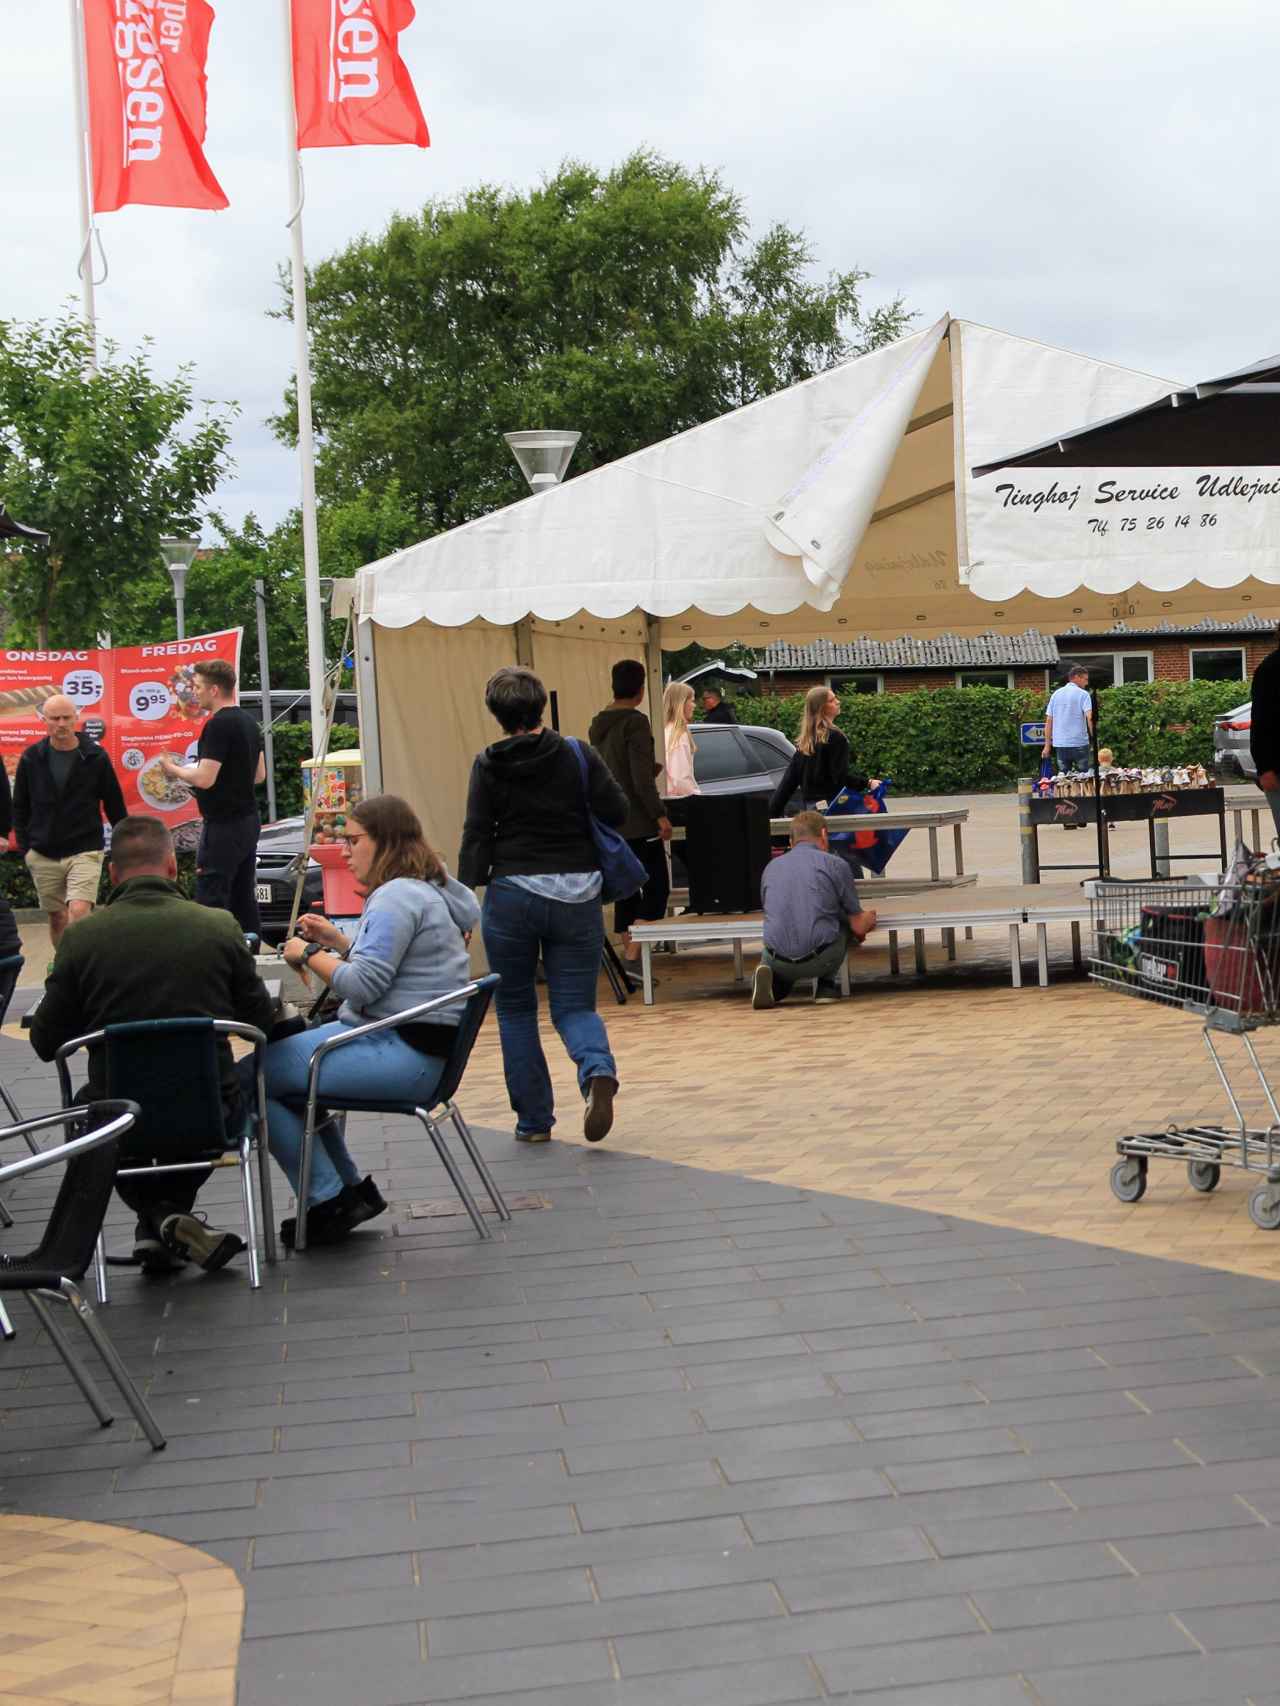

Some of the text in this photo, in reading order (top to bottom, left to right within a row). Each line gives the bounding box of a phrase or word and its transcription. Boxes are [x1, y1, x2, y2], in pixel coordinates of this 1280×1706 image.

[1095, 480, 1180, 504] Service
[1087, 519, 1109, 536] Tlf
[1121, 518, 1137, 531] 75
[1146, 516, 1164, 530] 26
[1199, 513, 1217, 527] 86
[6, 651, 89, 662] ONSDAG
[142, 640, 217, 657] FREDAG
